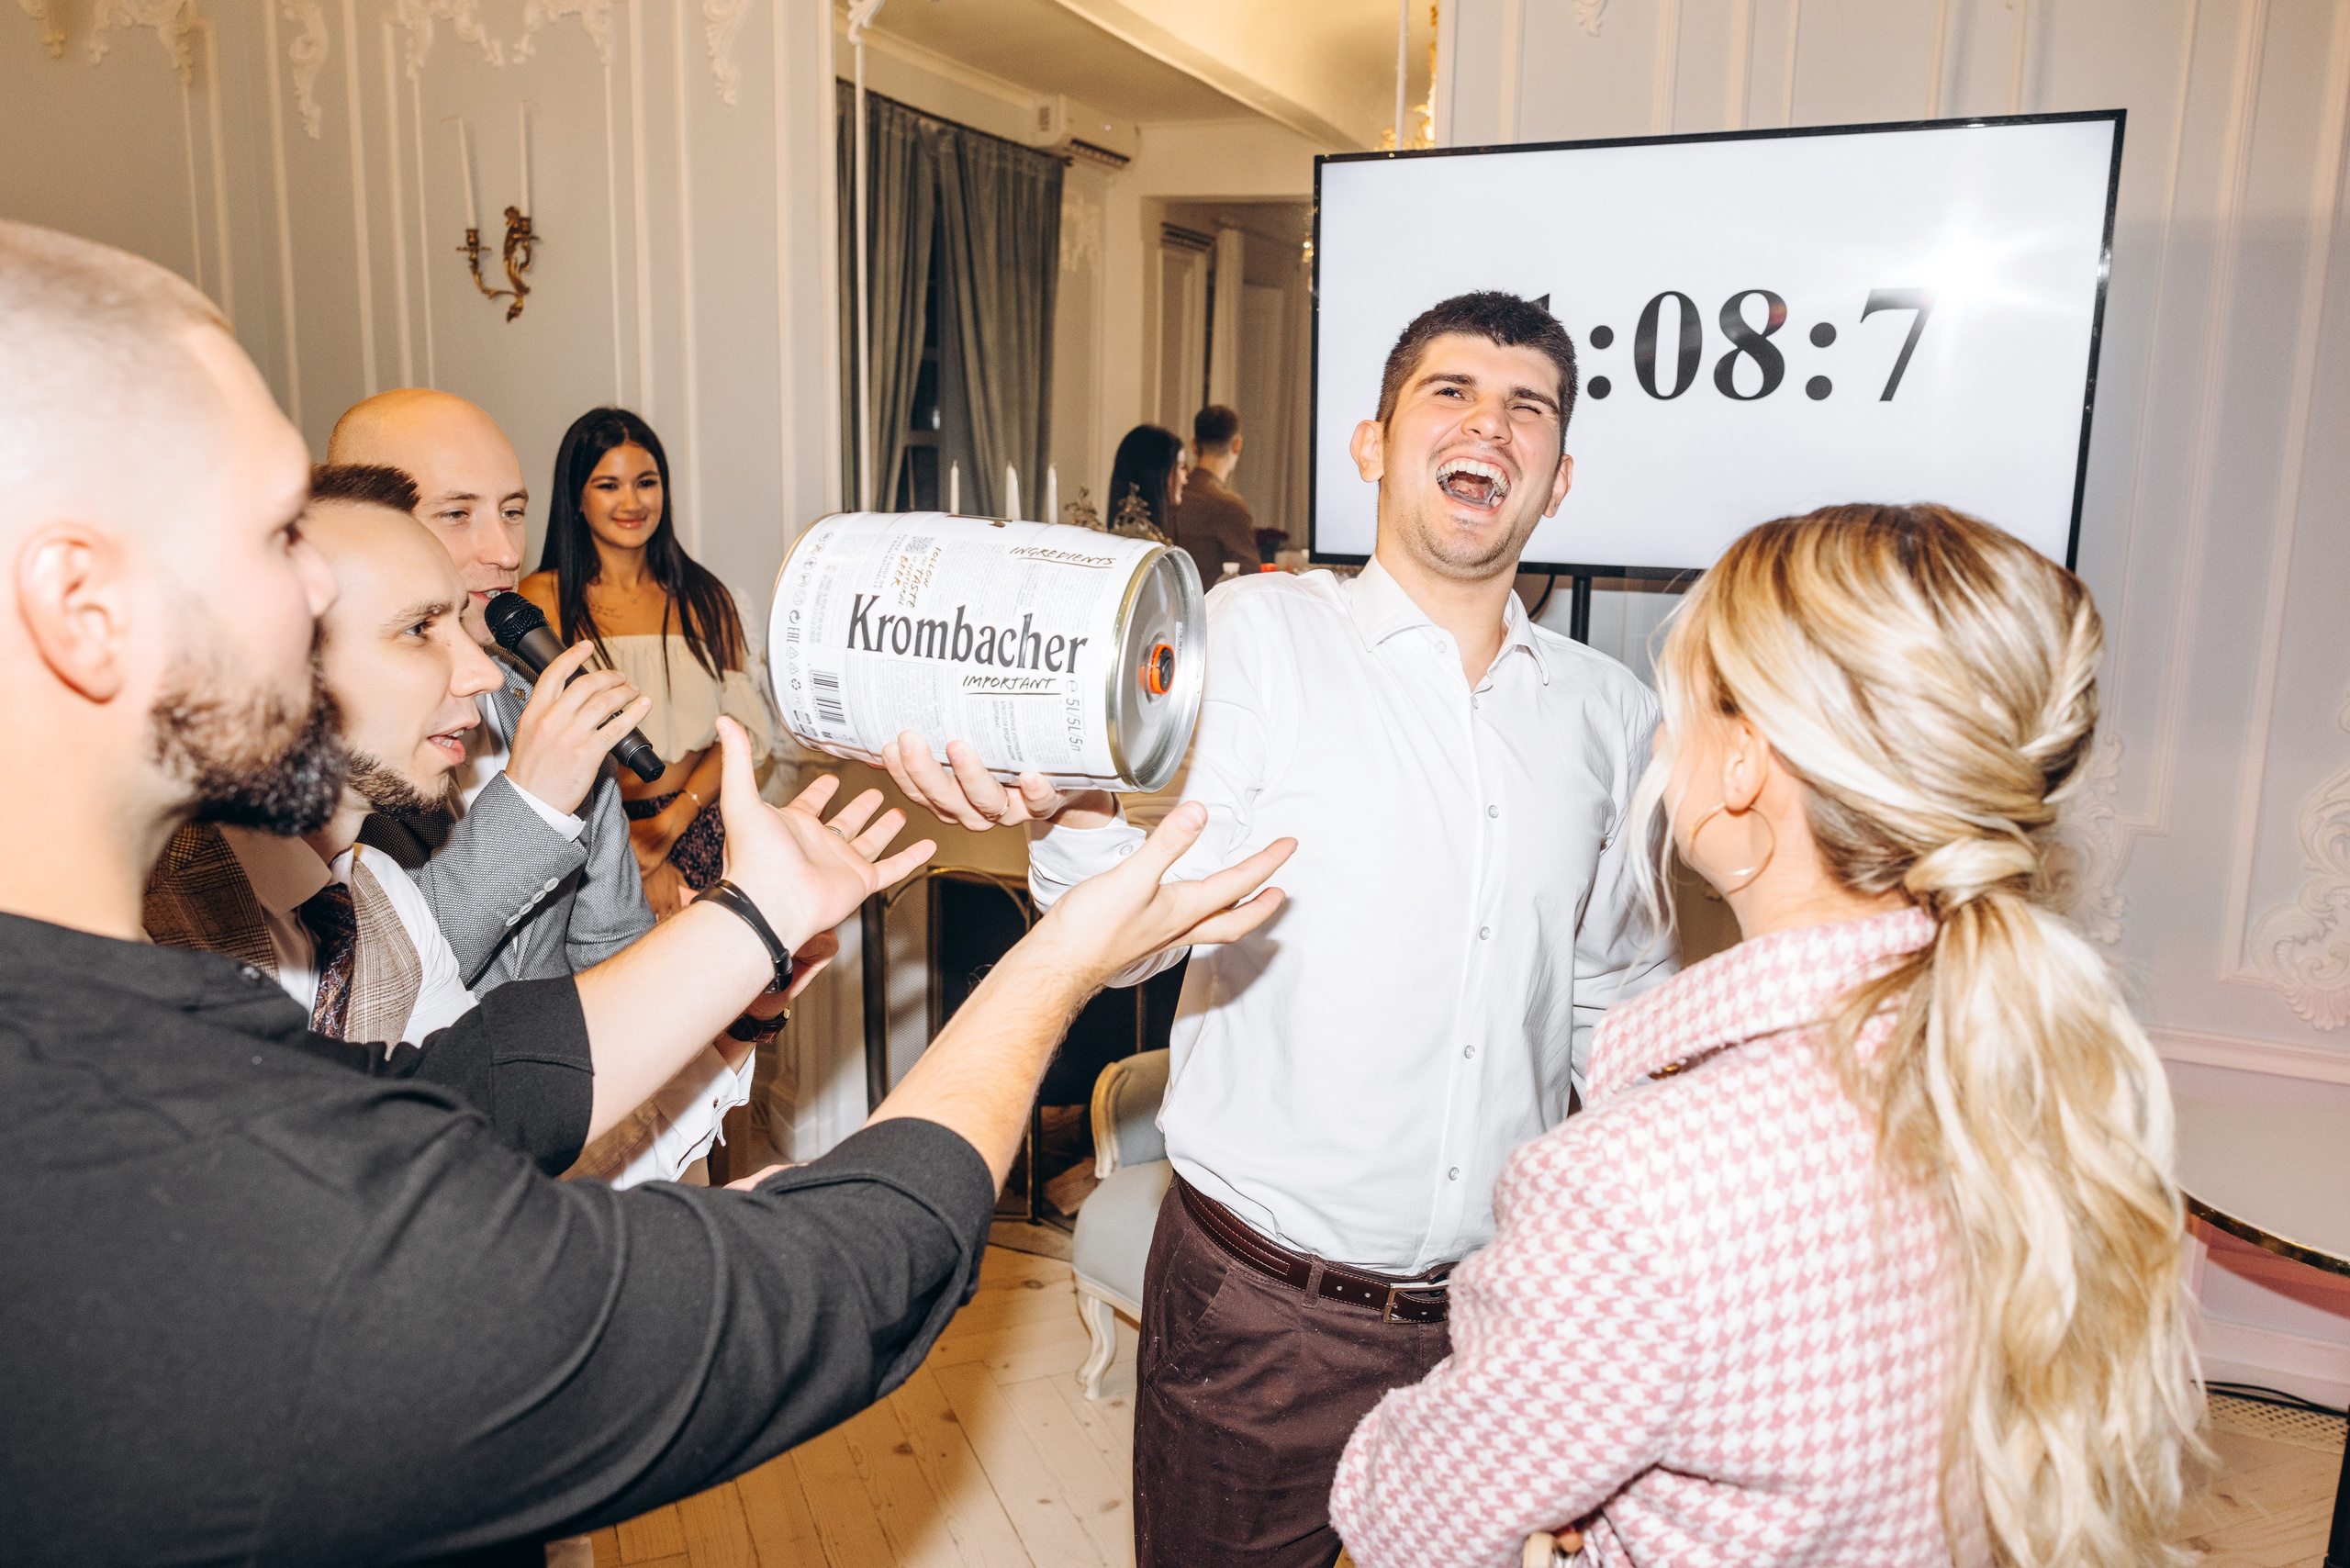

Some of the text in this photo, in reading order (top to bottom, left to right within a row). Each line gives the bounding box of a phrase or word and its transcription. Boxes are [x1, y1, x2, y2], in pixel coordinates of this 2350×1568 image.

[1532, 288, 1937, 402] :08:7
[890, 555, 909, 588] BEER
[923, 546, 942, 588] FOLLOW
[1009, 546, 1117, 566] INGREDIENTS
[899, 563, 913, 606] NATURAL
[907, 568, 923, 609] TASTE
[846, 593, 1089, 674] Krombacher
[962, 675, 1057, 689] IMPORTANT
